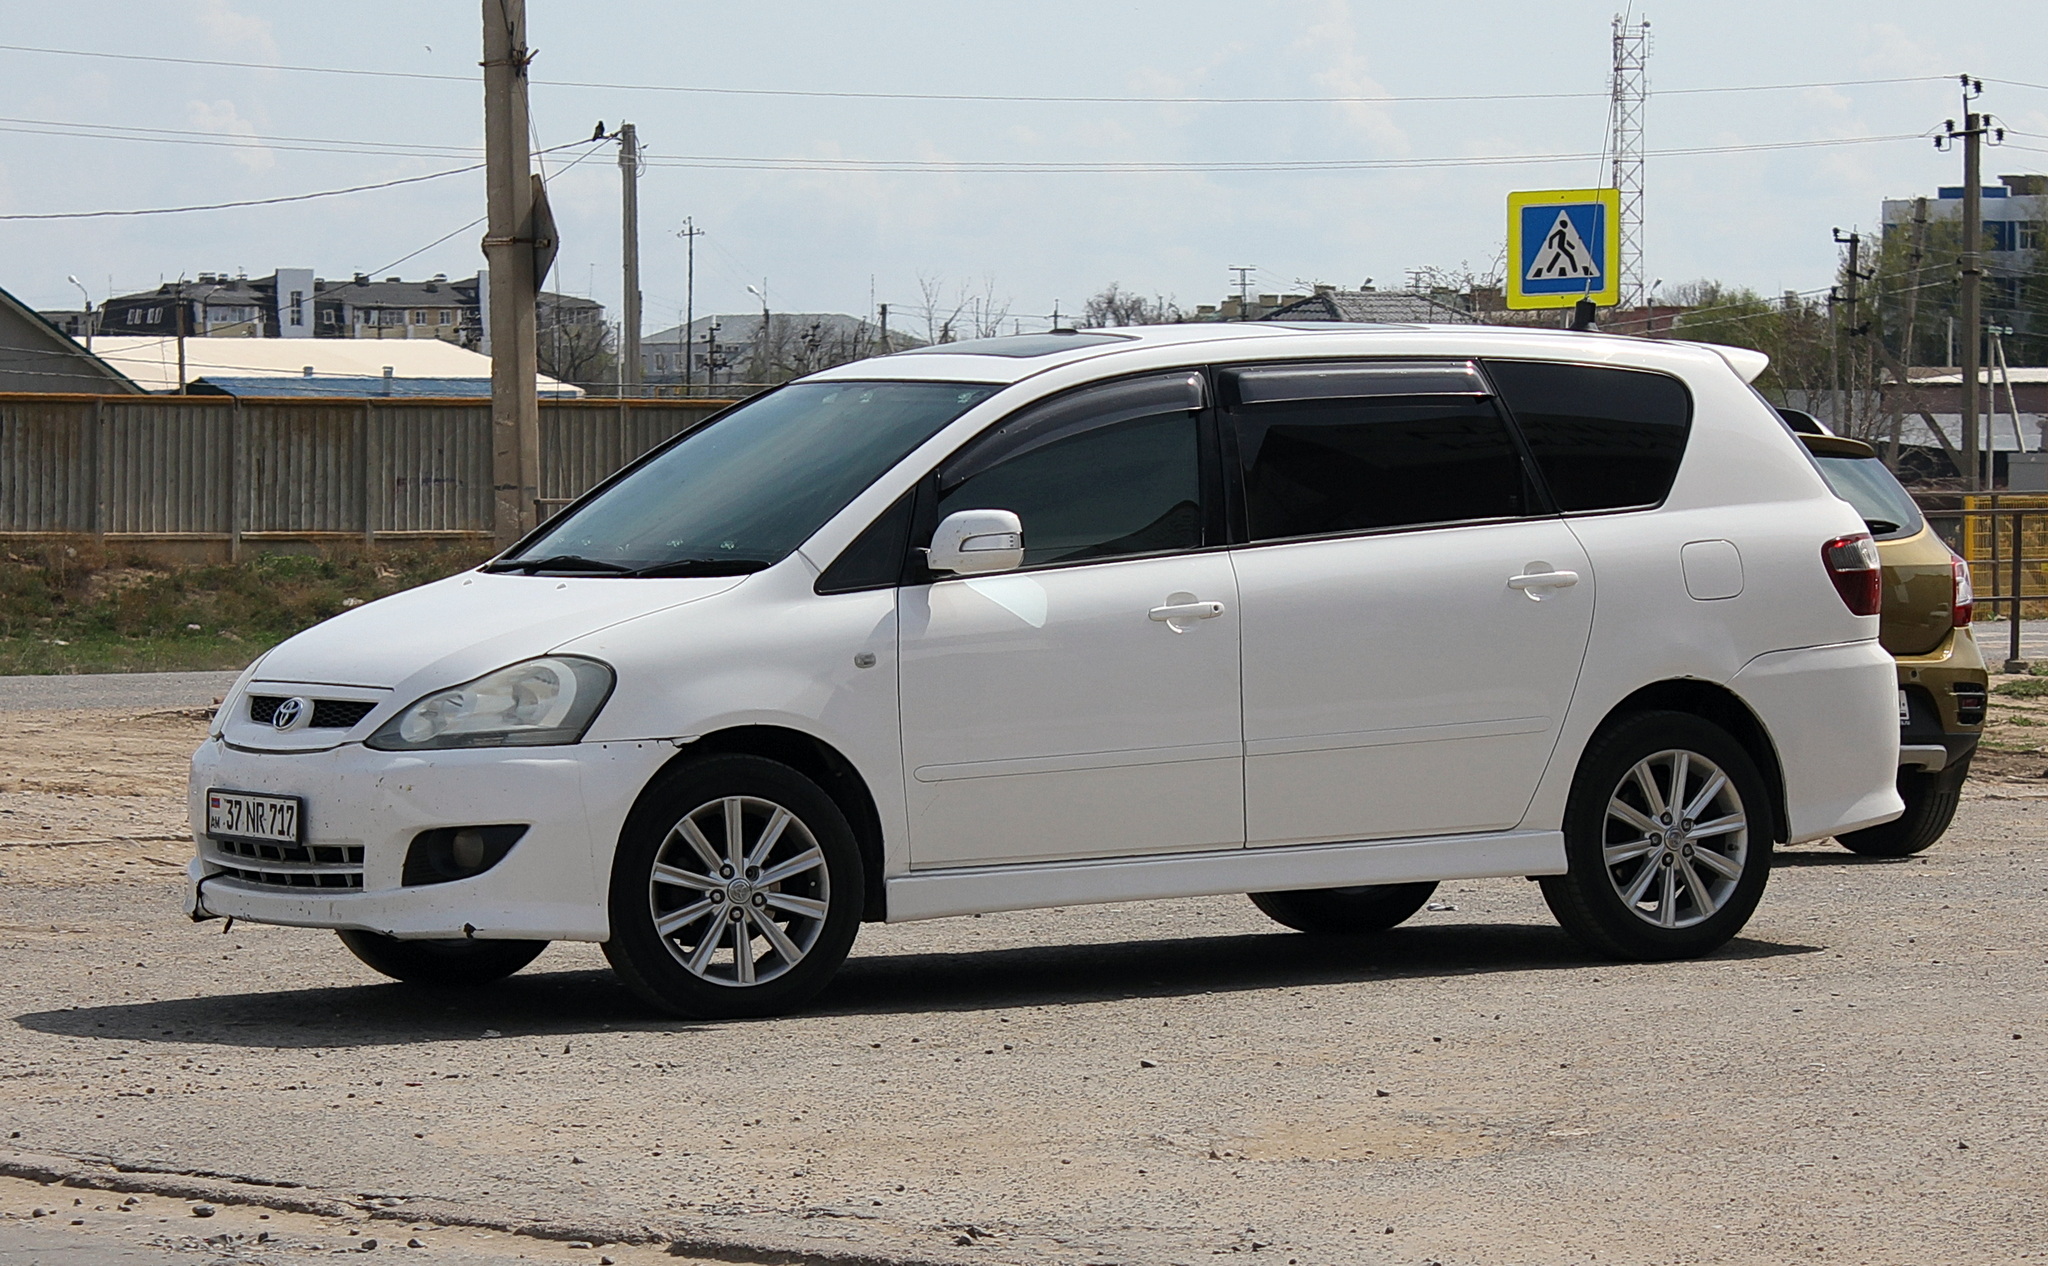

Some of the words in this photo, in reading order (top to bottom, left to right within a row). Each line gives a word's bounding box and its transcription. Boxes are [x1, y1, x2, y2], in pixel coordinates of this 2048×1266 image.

[211, 816, 220, 829] AM
[226, 799, 242, 831] 37
[246, 801, 265, 834] NR
[269, 803, 295, 837] 717
